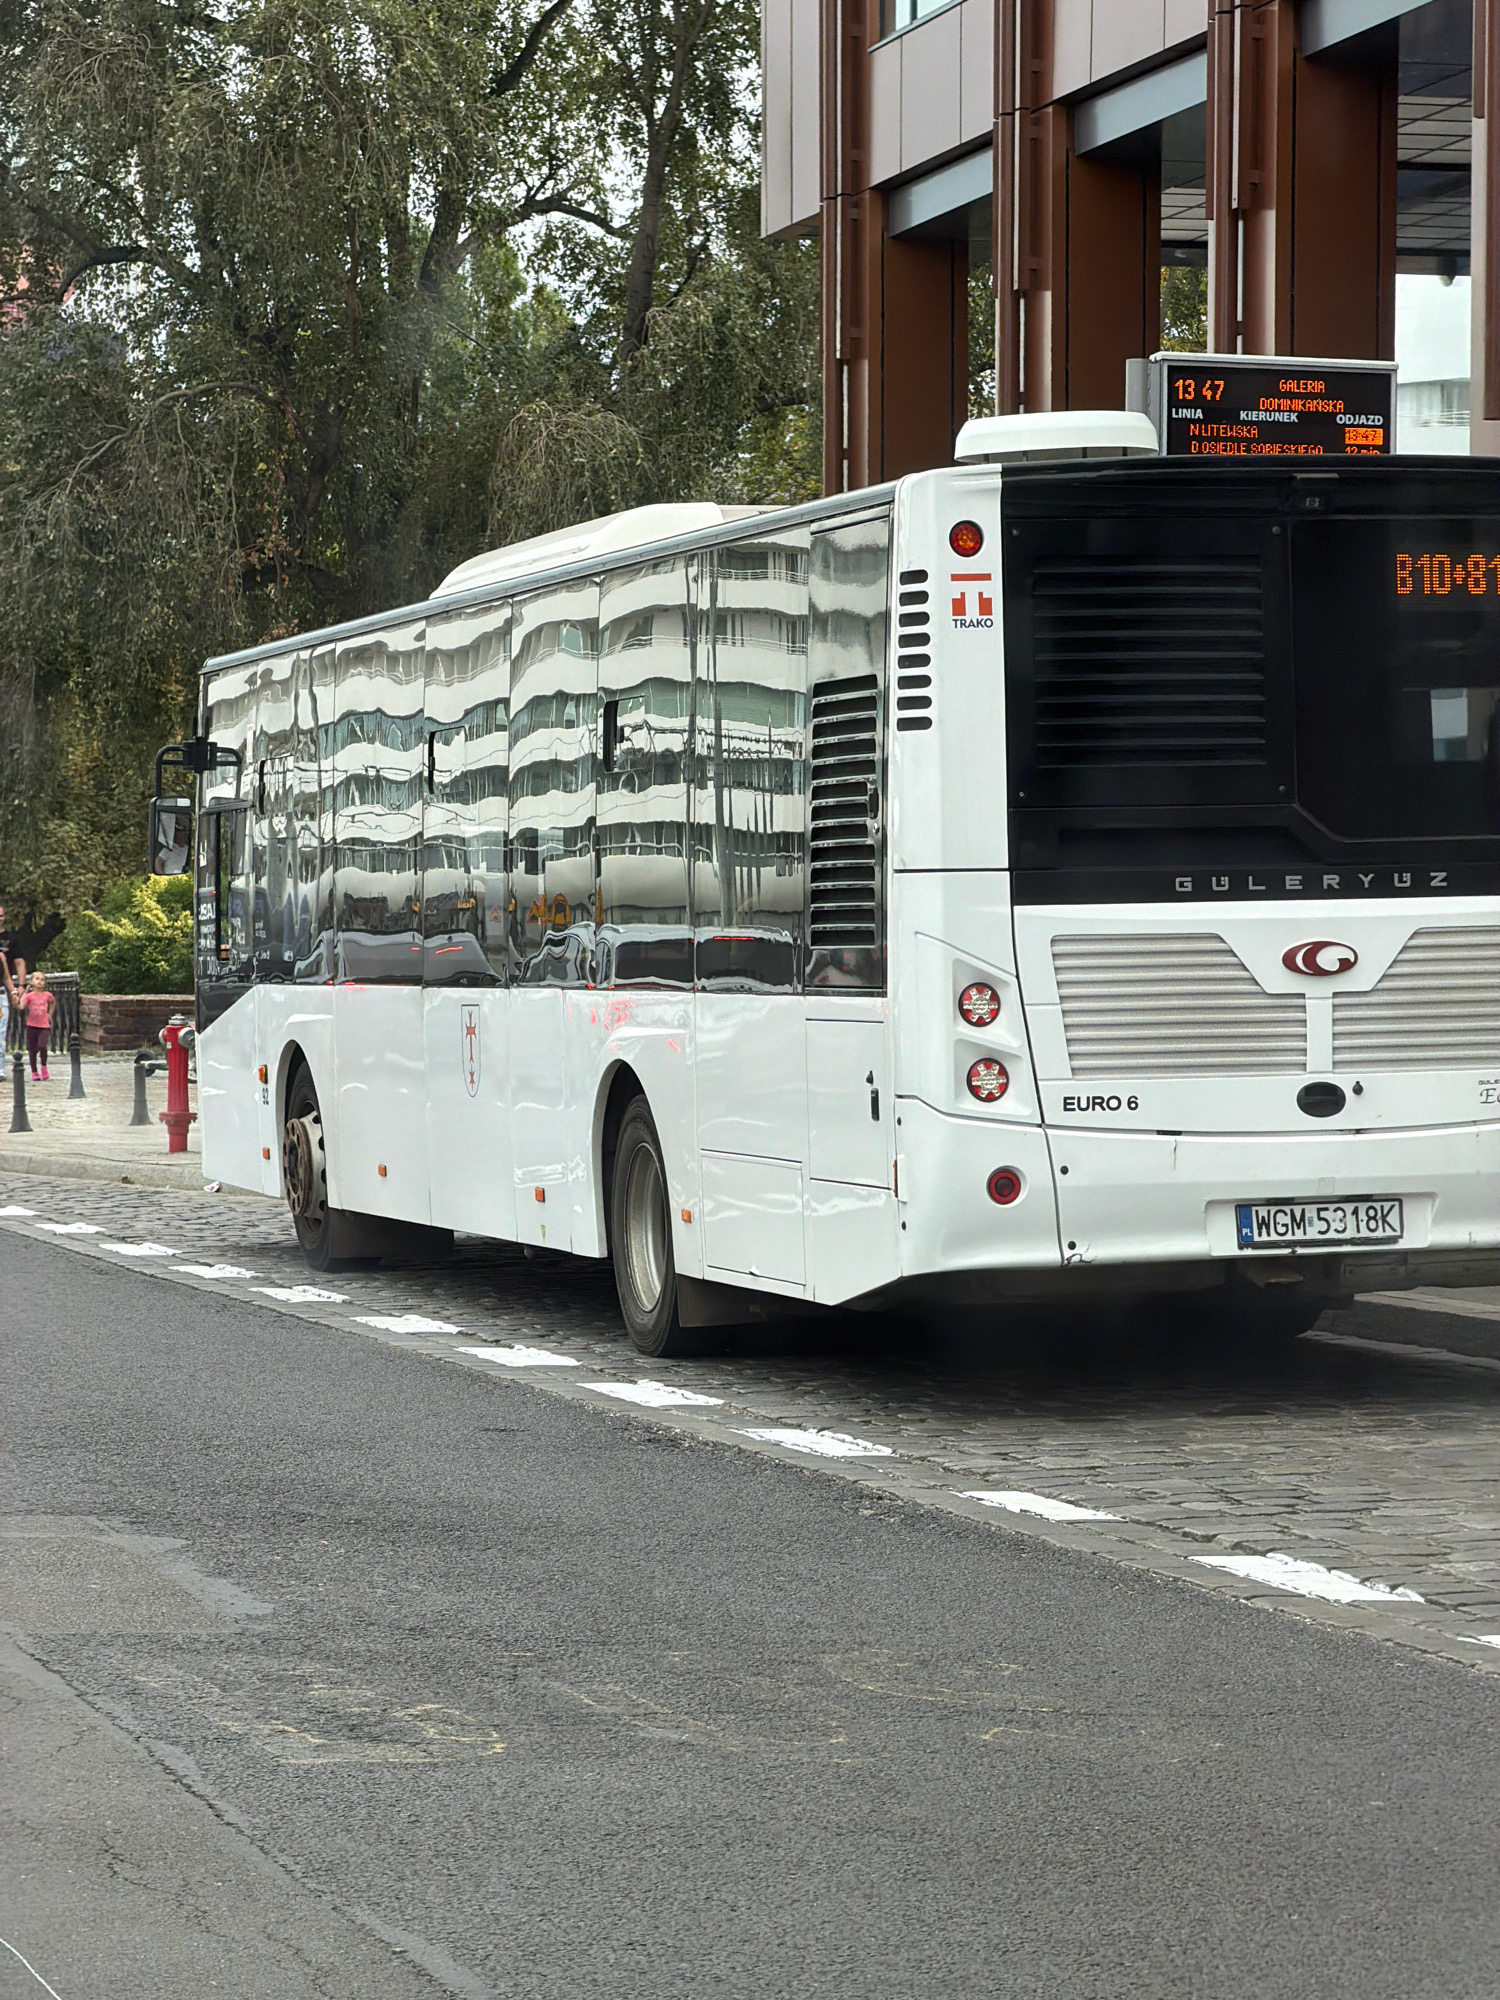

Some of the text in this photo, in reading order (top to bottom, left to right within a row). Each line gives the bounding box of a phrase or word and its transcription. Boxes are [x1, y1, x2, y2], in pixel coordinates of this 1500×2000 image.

[1174, 379, 1225, 401] 13 47
[1279, 379, 1325, 393] GALERIA
[1259, 397, 1344, 413] DOMINIKAŃSKA
[1171, 408, 1384, 426] LINIA KIERUNEK ODJAZD
[1189, 424, 1199, 436] N
[1202, 424, 1259, 438] LITEWSKA
[1191, 441, 1199, 454] D
[1202, 441, 1248, 455] OSIEDLE
[952, 618, 994, 629] TRAKO
[1175, 871, 1448, 892] GÜLERYÜZ
[1063, 1095, 1139, 1112] EURO 6
[1242, 1204, 1398, 1238] PL WGM 5318K
